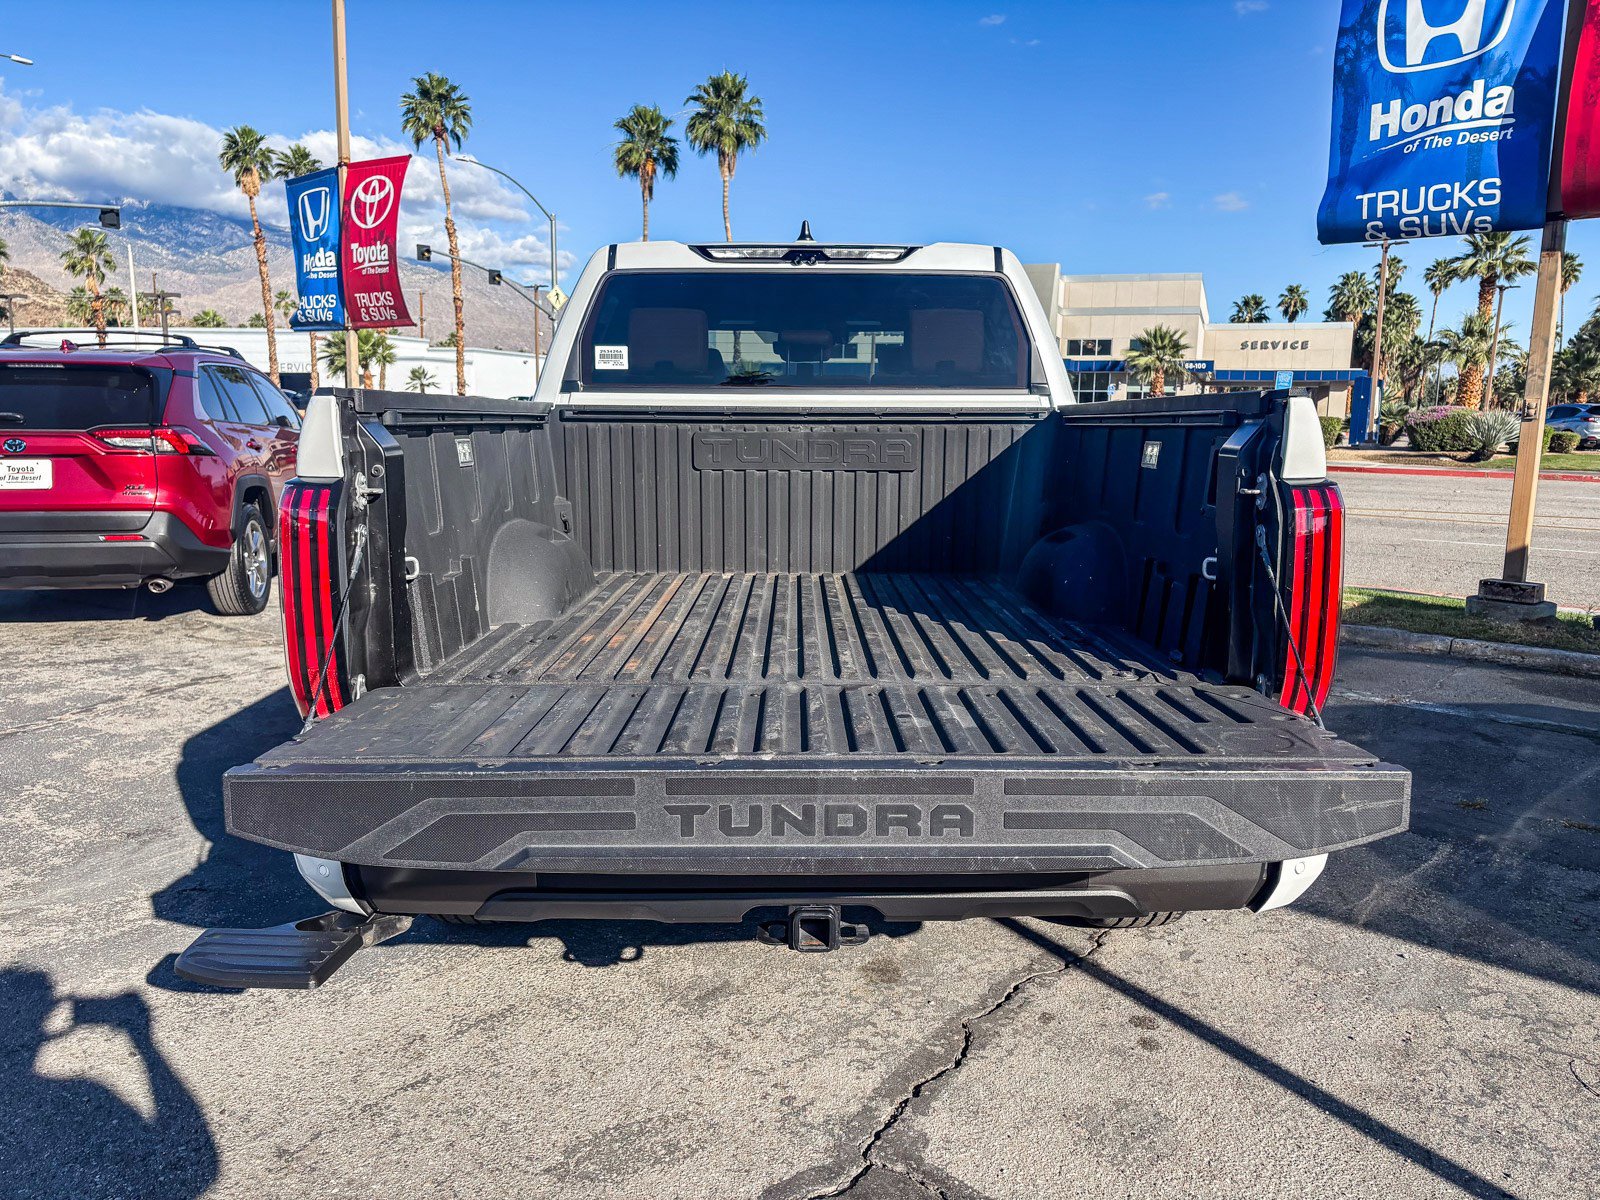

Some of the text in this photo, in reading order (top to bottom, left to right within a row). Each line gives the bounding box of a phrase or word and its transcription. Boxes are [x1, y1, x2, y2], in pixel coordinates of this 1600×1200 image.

[1369, 79, 1515, 141] Honda
[1403, 126, 1514, 154] of The Desert
[1355, 177, 1502, 220] TRUCKS
[1365, 209, 1493, 241] & SUVs
[350, 241, 389, 267] Toyota
[299, 294, 337, 310] RUCKS
[354, 291, 394, 308] TRUCKS
[296, 308, 333, 323] & SUVs
[361, 306, 398, 321] & SUVs
[1240, 340, 1310, 350] SERVICE
[701, 438, 912, 463] TUNDRA
[6, 465, 35, 474] Toyota
[663, 803, 974, 838] TUNDRA
